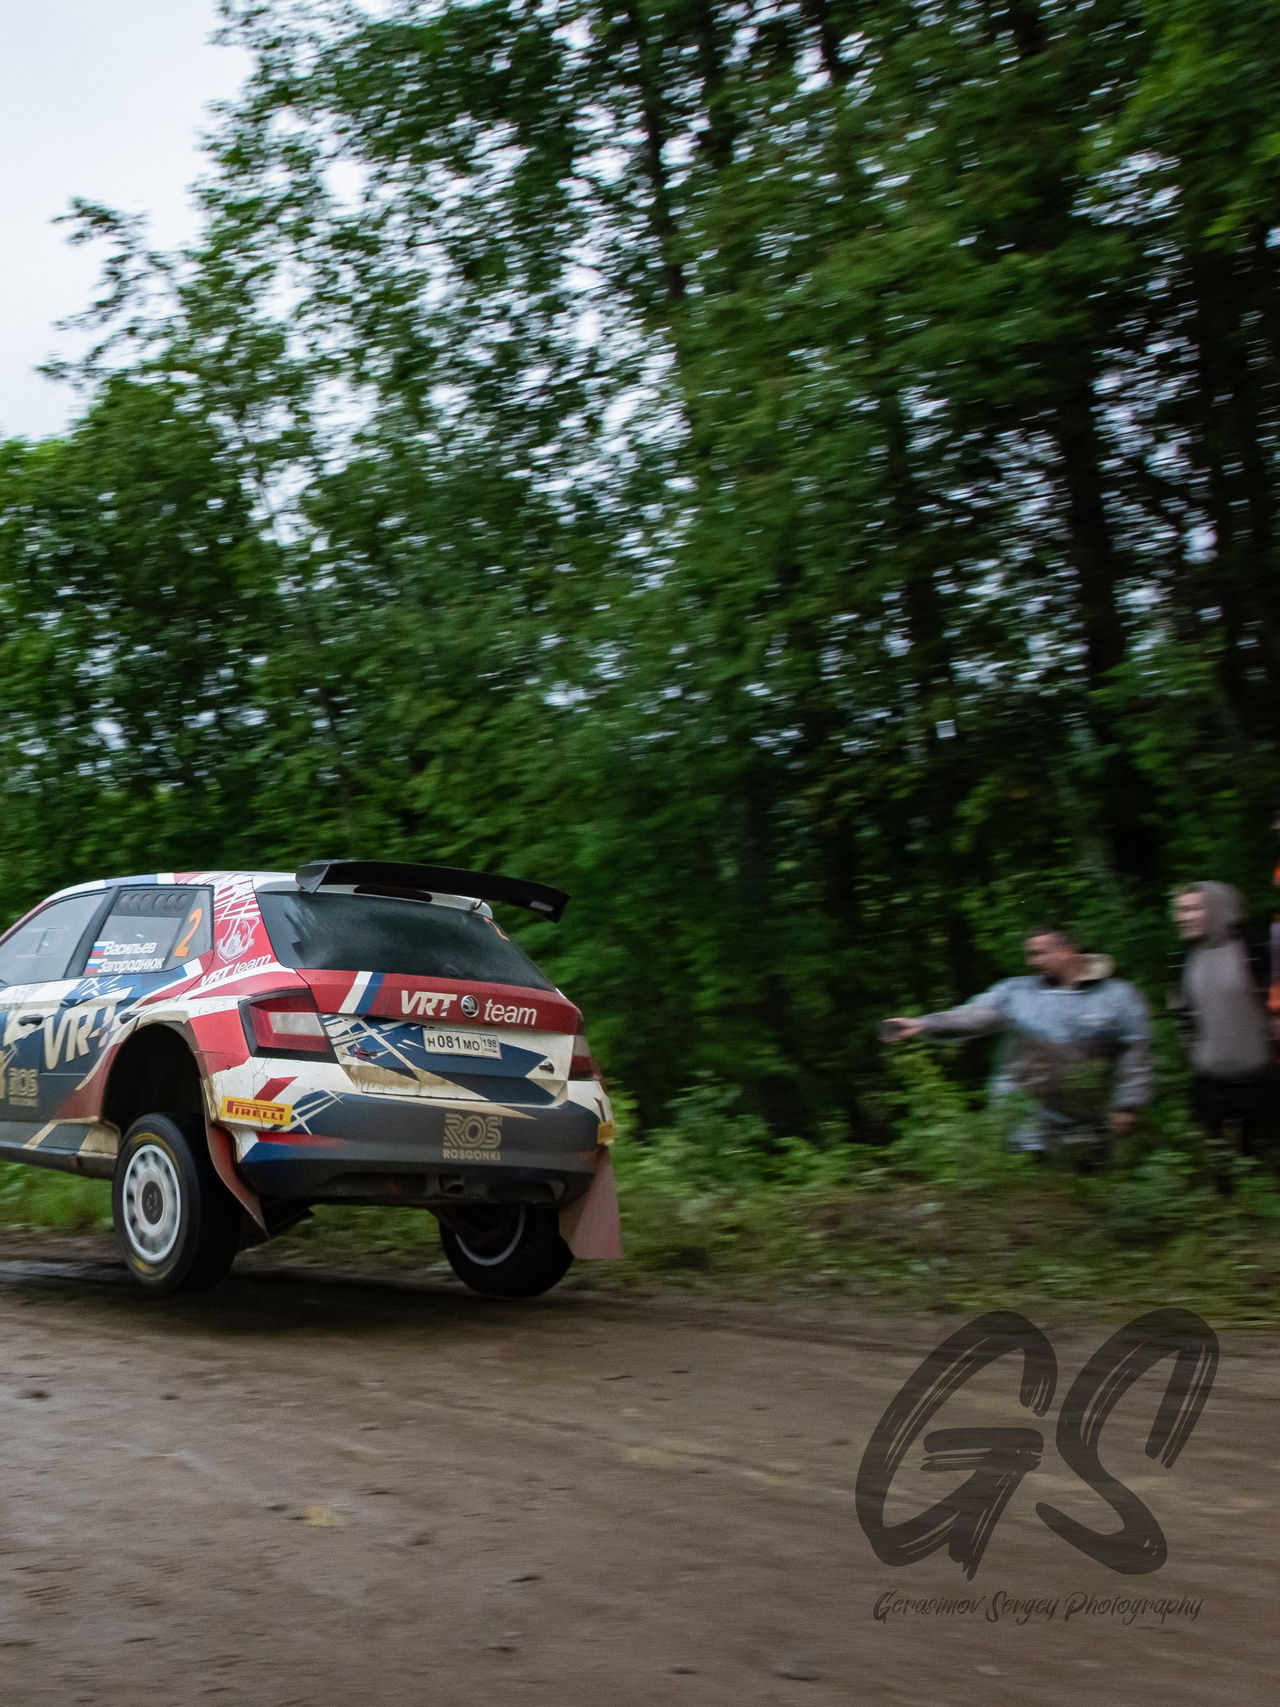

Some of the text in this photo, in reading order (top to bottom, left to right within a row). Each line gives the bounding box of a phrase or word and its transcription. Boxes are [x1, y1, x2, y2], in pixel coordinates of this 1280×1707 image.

[103, 941, 157, 955] Васильев
[174, 908, 203, 957] 2
[97, 958, 165, 973] Загороднюк
[201, 954, 272, 987] VRT team
[401, 990, 537, 1026] VRT team
[43, 986, 134, 1070] VRT
[227, 1100, 286, 1121] PIRELLI
[443, 1113, 503, 1149] ROS
[442, 1148, 501, 1161] ROSGONKI
